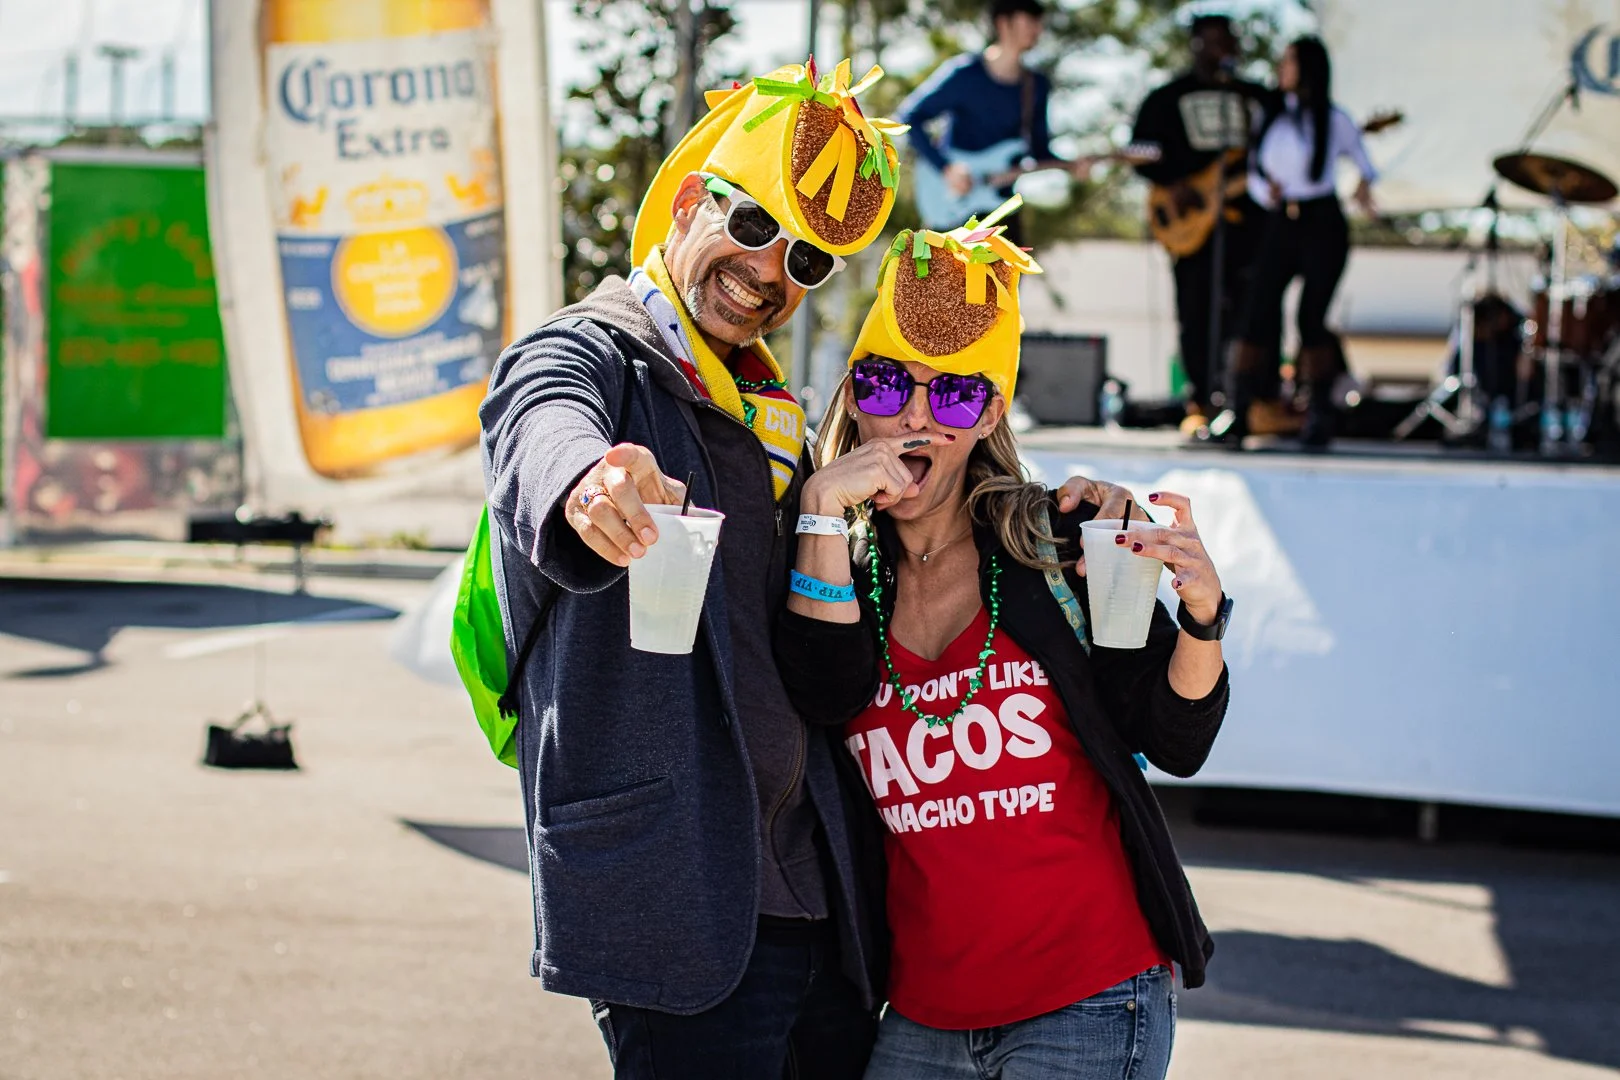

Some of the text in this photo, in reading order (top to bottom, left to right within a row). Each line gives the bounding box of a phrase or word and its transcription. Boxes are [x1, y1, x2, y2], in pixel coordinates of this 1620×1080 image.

[278, 57, 479, 128] Corona
[335, 118, 451, 161] Extra
[795, 577, 812, 592] VIP
[819, 586, 842, 599] VIP
[988, 660, 1049, 690] LIKE
[844, 692, 1052, 800] TACOS
[978, 782, 1056, 820] TYPE
